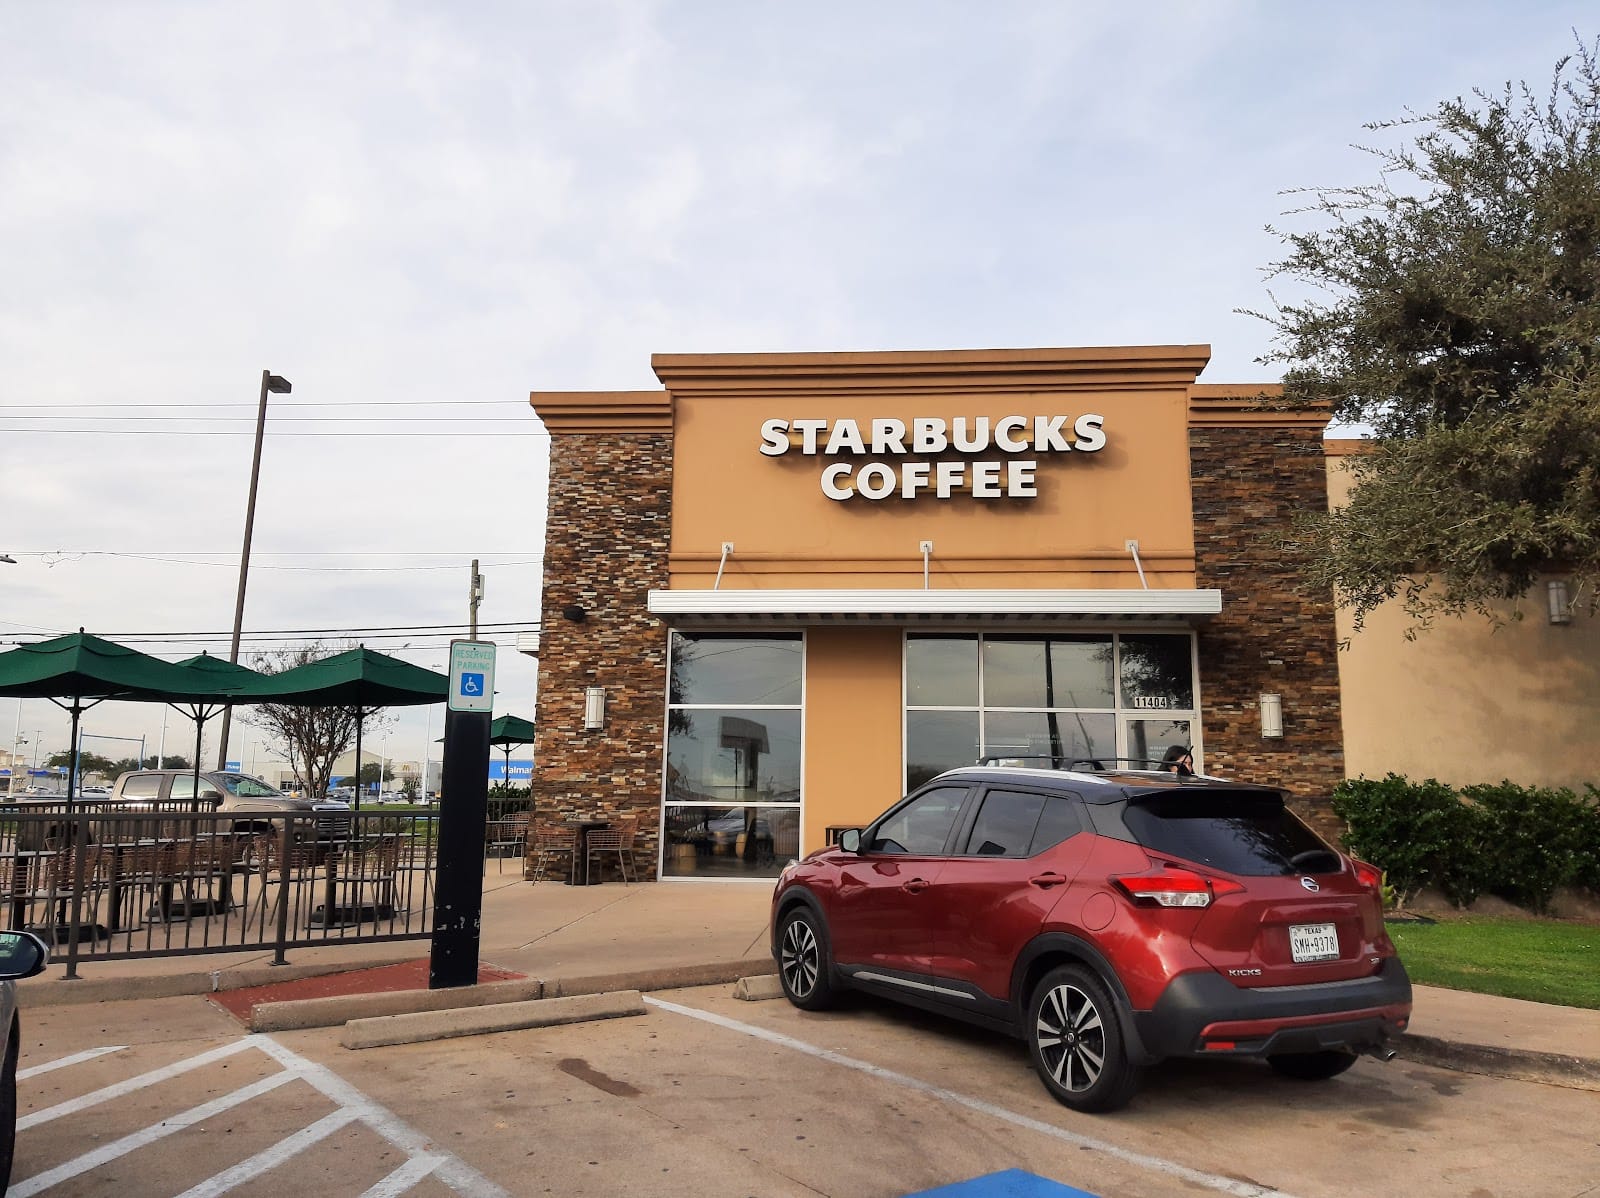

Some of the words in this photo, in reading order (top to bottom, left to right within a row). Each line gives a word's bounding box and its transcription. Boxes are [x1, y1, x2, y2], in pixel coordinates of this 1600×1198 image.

[759, 413, 1107, 456] STARBUCKS
[820, 460, 1038, 501] COFFEE
[455, 649, 494, 660] RESERVED
[457, 660, 491, 671] PARKING
[1135, 697, 1167, 708] 11404
[500, 765, 532, 774] Walmar
[1304, 927, 1322, 935] TEXAS
[1228, 968, 1262, 977] KICKS
